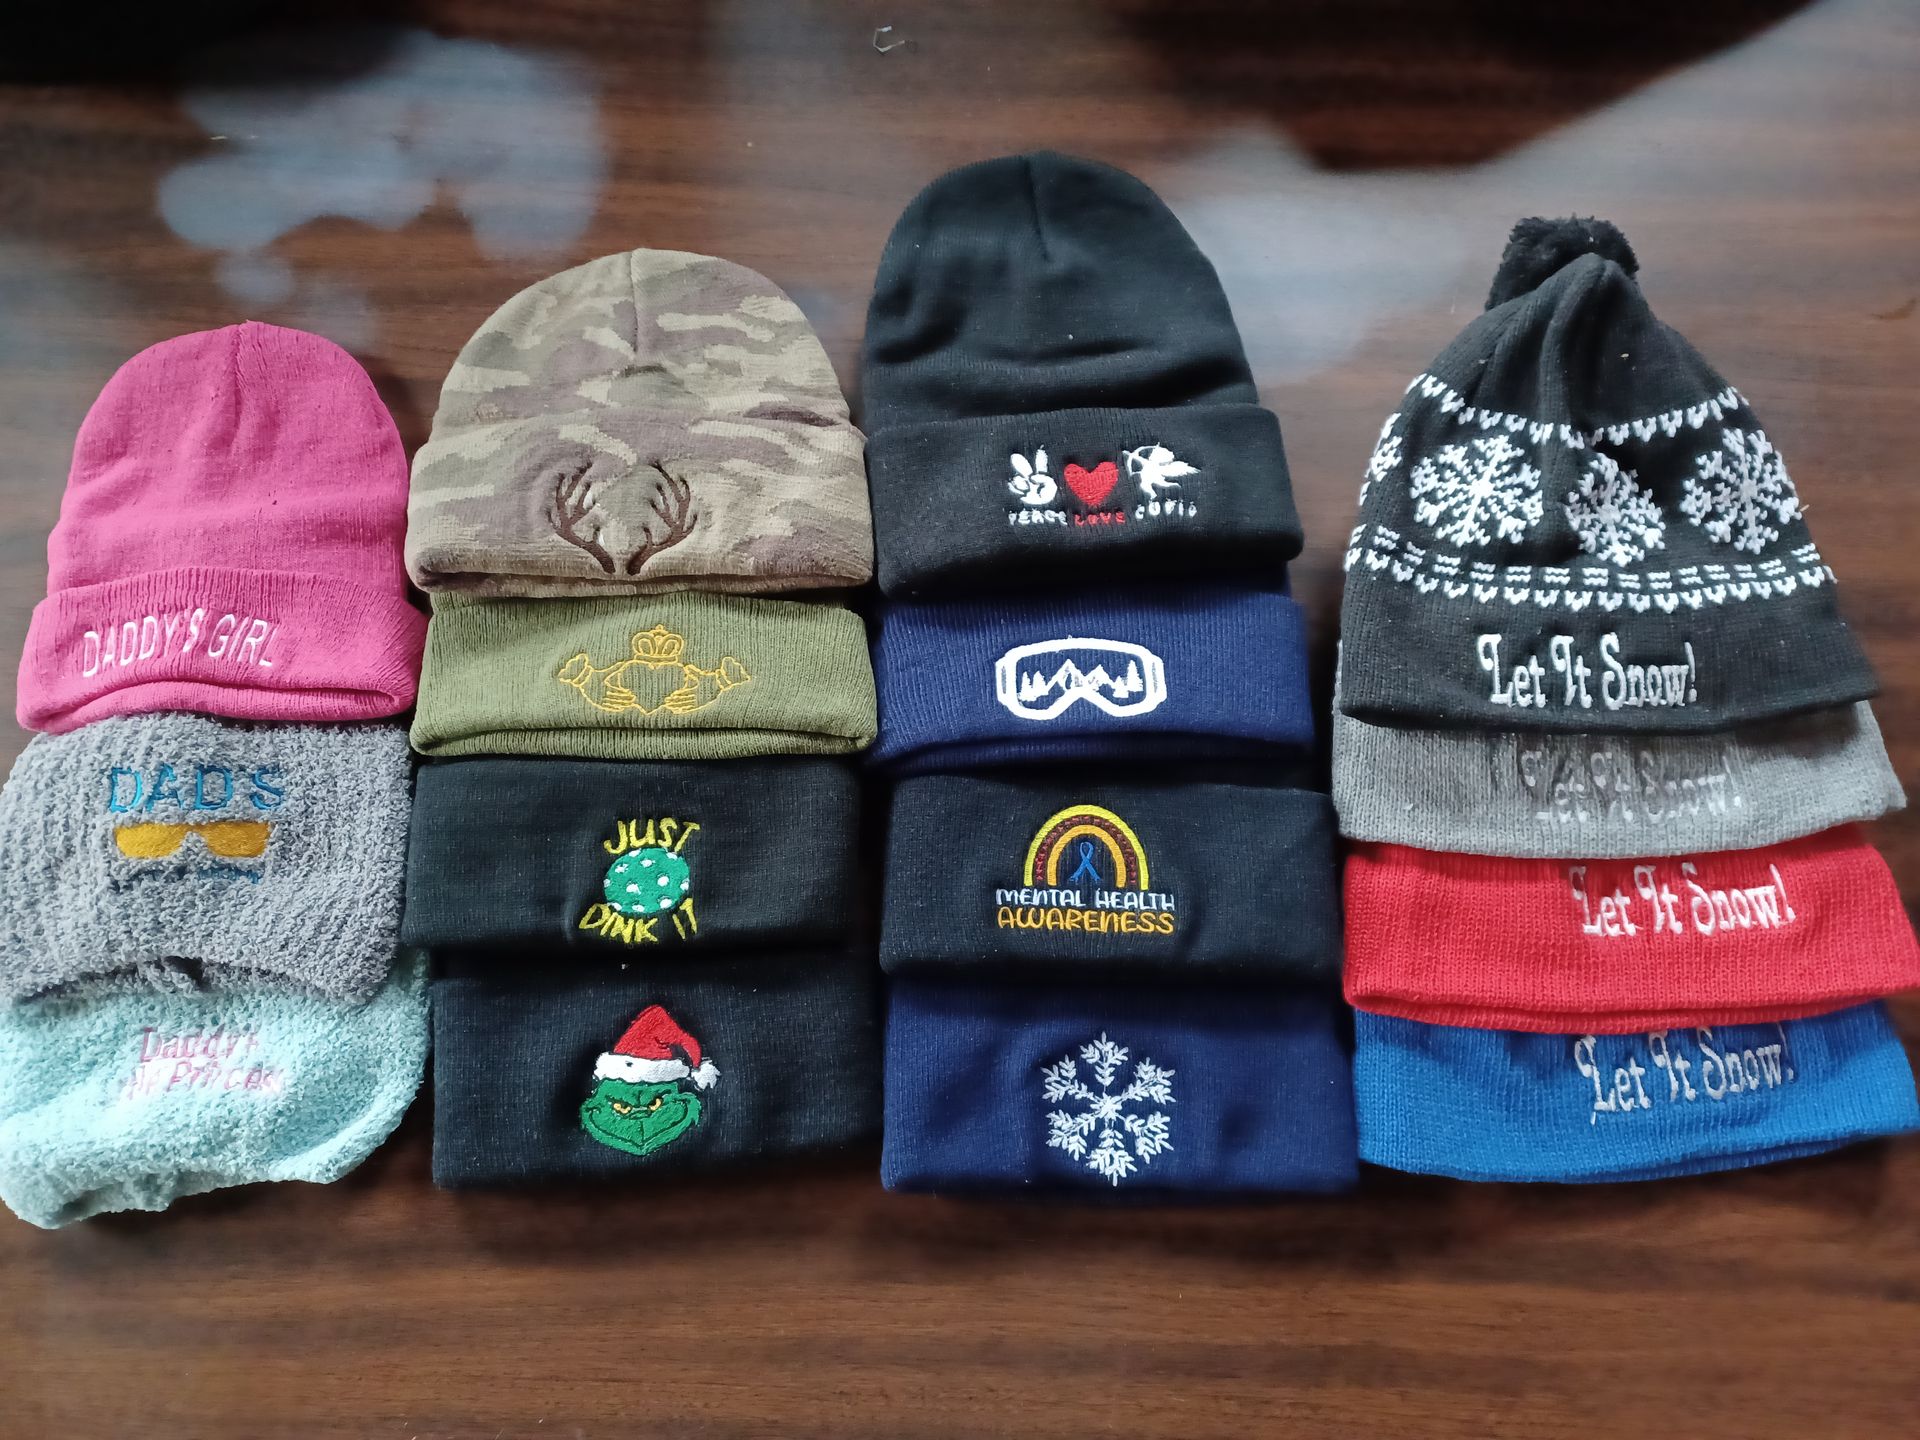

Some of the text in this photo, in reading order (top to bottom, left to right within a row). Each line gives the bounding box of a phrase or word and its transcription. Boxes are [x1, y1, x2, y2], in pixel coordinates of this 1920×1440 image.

[1008, 508, 1068, 526] PEACE
[1074, 511, 1126, 526] LOVE
[207, 613, 279, 667] GIRL
[1478, 632, 1697, 710] Let It Snow!
[603, 817, 700, 854] JUST
[579, 898, 697, 943] DINK IT
[995, 888, 1175, 911] MENTAL HEALTH
[997, 906, 1175, 935] AWARENESS
[1568, 862, 1796, 936] Let It Snow!
[1574, 1022, 1795, 1112] Let It Snow!
